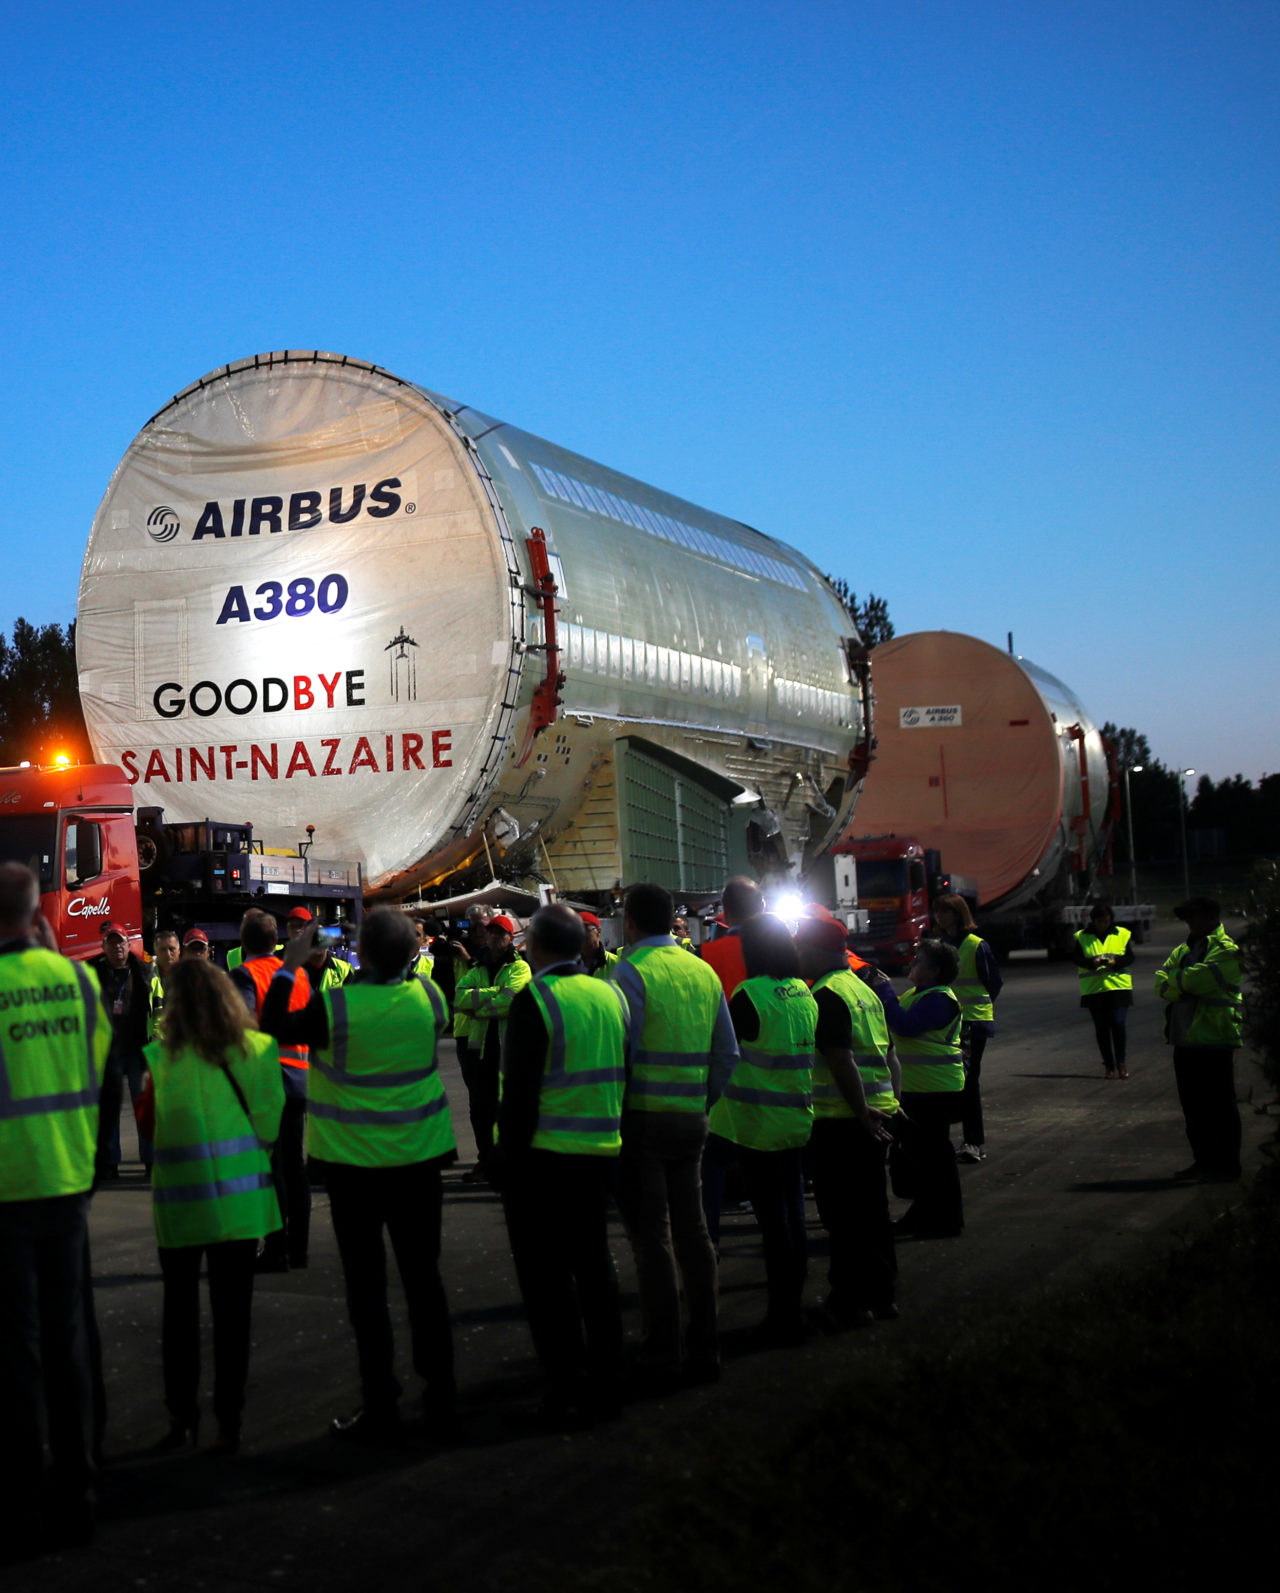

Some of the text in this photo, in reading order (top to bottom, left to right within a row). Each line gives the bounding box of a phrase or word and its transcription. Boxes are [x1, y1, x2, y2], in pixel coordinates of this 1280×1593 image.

[216, 573, 349, 625] A380
[153, 669, 366, 718] GOODBYE
[121, 729, 454, 785] SAINT-NAZAIRE
[67, 897, 111, 920] Capelle
[9, 1017, 80, 1041] CONVOI
